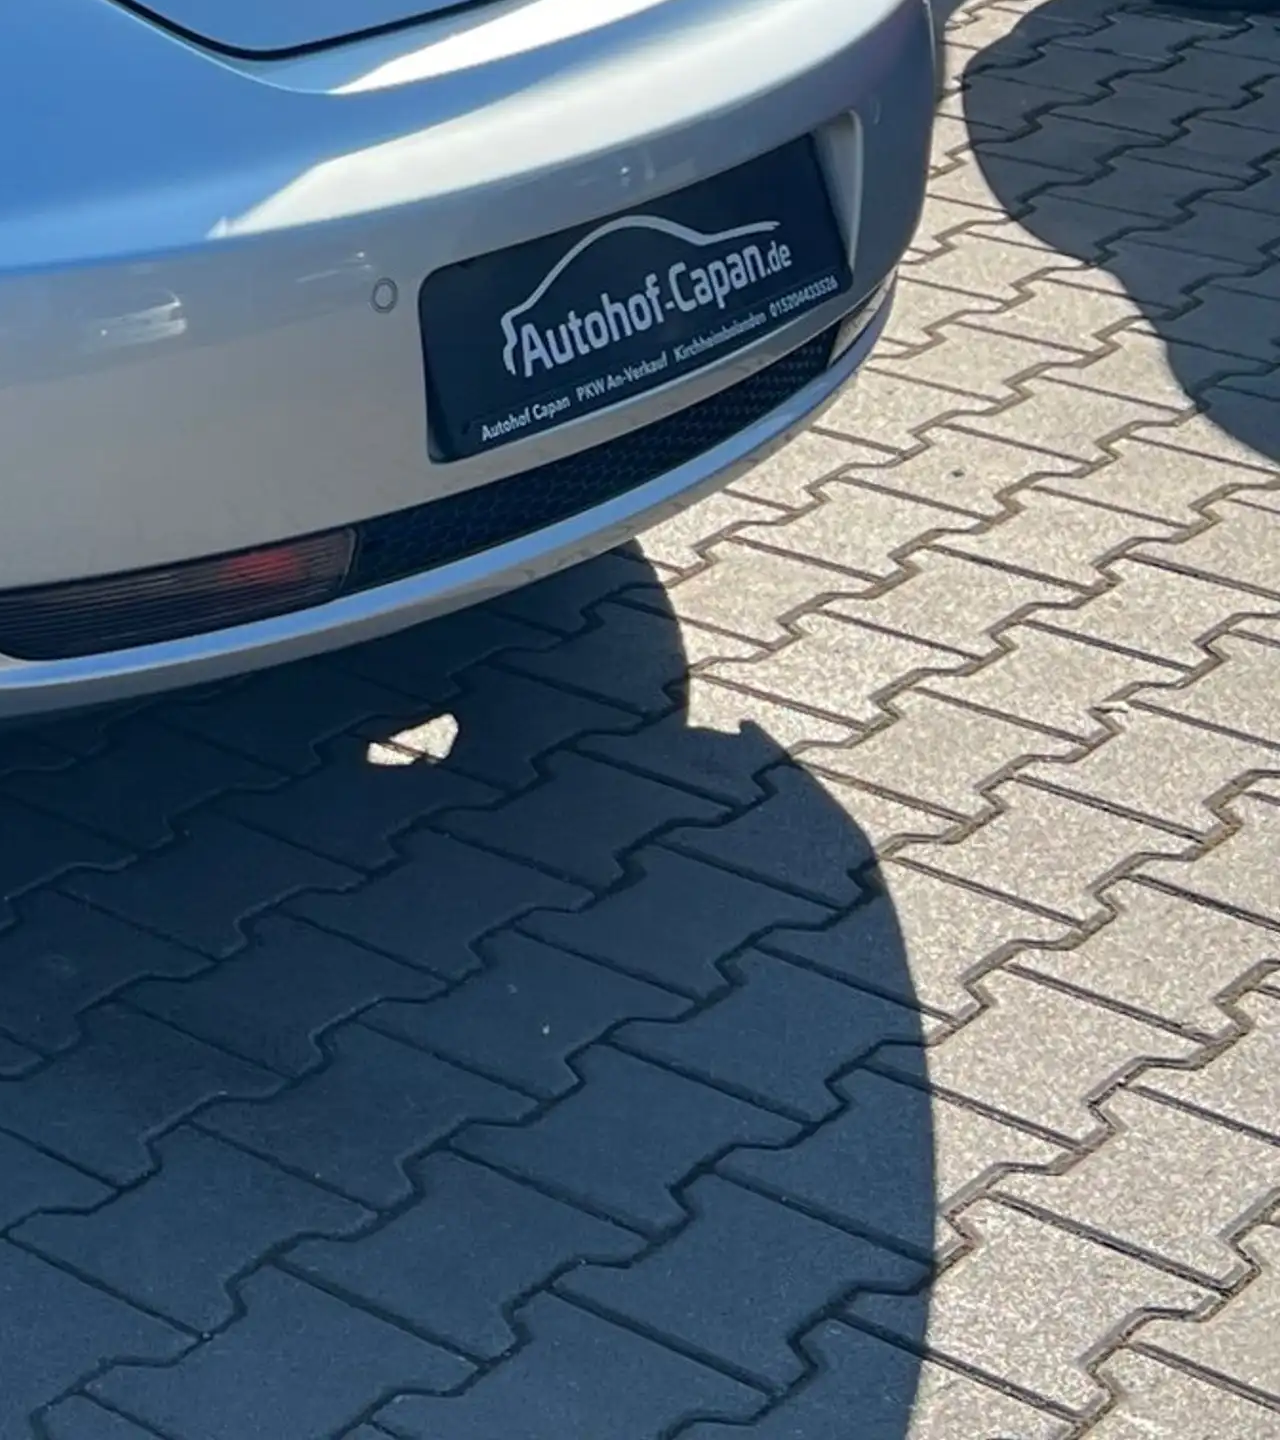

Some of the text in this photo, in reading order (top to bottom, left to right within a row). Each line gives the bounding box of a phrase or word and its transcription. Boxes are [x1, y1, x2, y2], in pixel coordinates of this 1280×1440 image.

[521, 240, 793, 378] Autohof-Capan.de
[481, 408, 531, 441] Autohof
[532, 396, 571, 420] Capan
[575, 381, 606, 402] PKW
